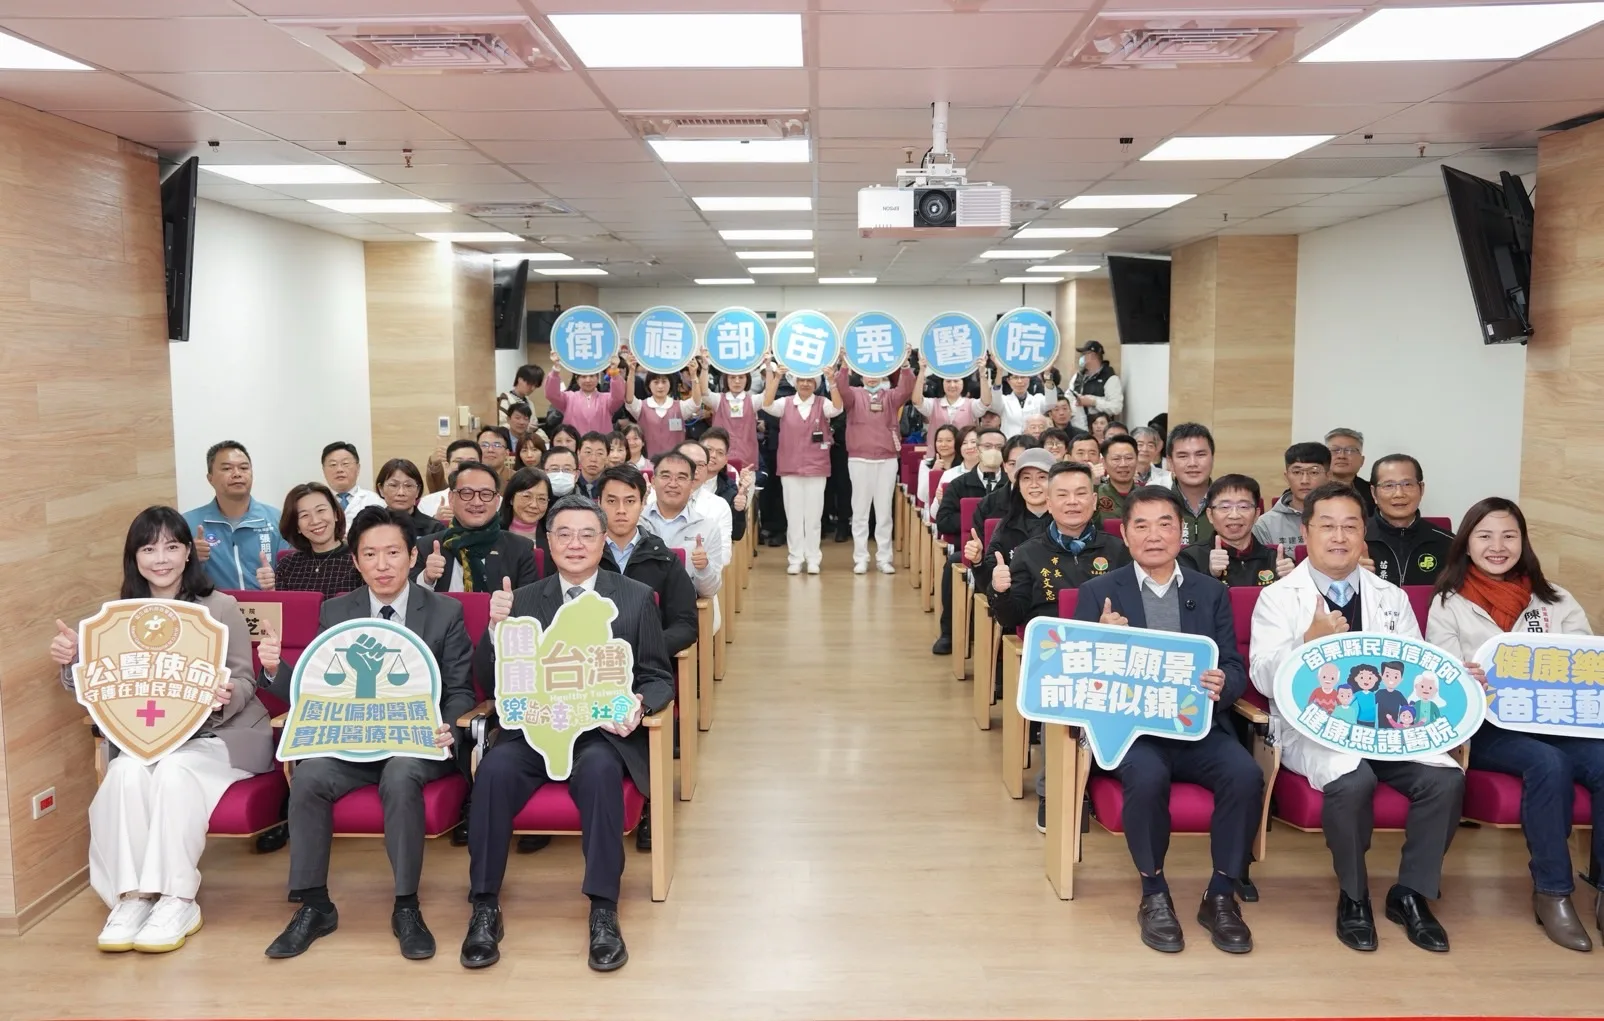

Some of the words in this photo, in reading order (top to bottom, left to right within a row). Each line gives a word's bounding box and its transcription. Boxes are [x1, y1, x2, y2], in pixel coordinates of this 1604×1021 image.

[565, 321, 604, 361] 衛
[644, 320, 684, 360] 福
[717, 321, 756, 361] 部
[784, 323, 829, 366] 苗
[855, 324, 895, 364] 栗
[932, 323, 973, 367] 醫
[1006, 322, 1048, 362] 院
[1040, 567, 1056, 601] 余文忠
[1050, 556, 1063, 578] 市長
[86, 651, 217, 689] 公醫使命
[502, 625, 536, 693] 健康
[541, 641, 628, 693] 台灣
[1060, 640, 1196, 687] 苗栗願景
[1302, 636, 1461, 685] 苗栗縣民最信賴的
[84, 680, 215, 706] 守護在地民眾健康
[300, 700, 430, 722] 優化偏鄉醫療
[1040, 674, 1178, 720] 前程似錦
[289, 725, 437, 750] 實現醫療平權
[1298, 702, 1458, 755] 健康照護醫院
